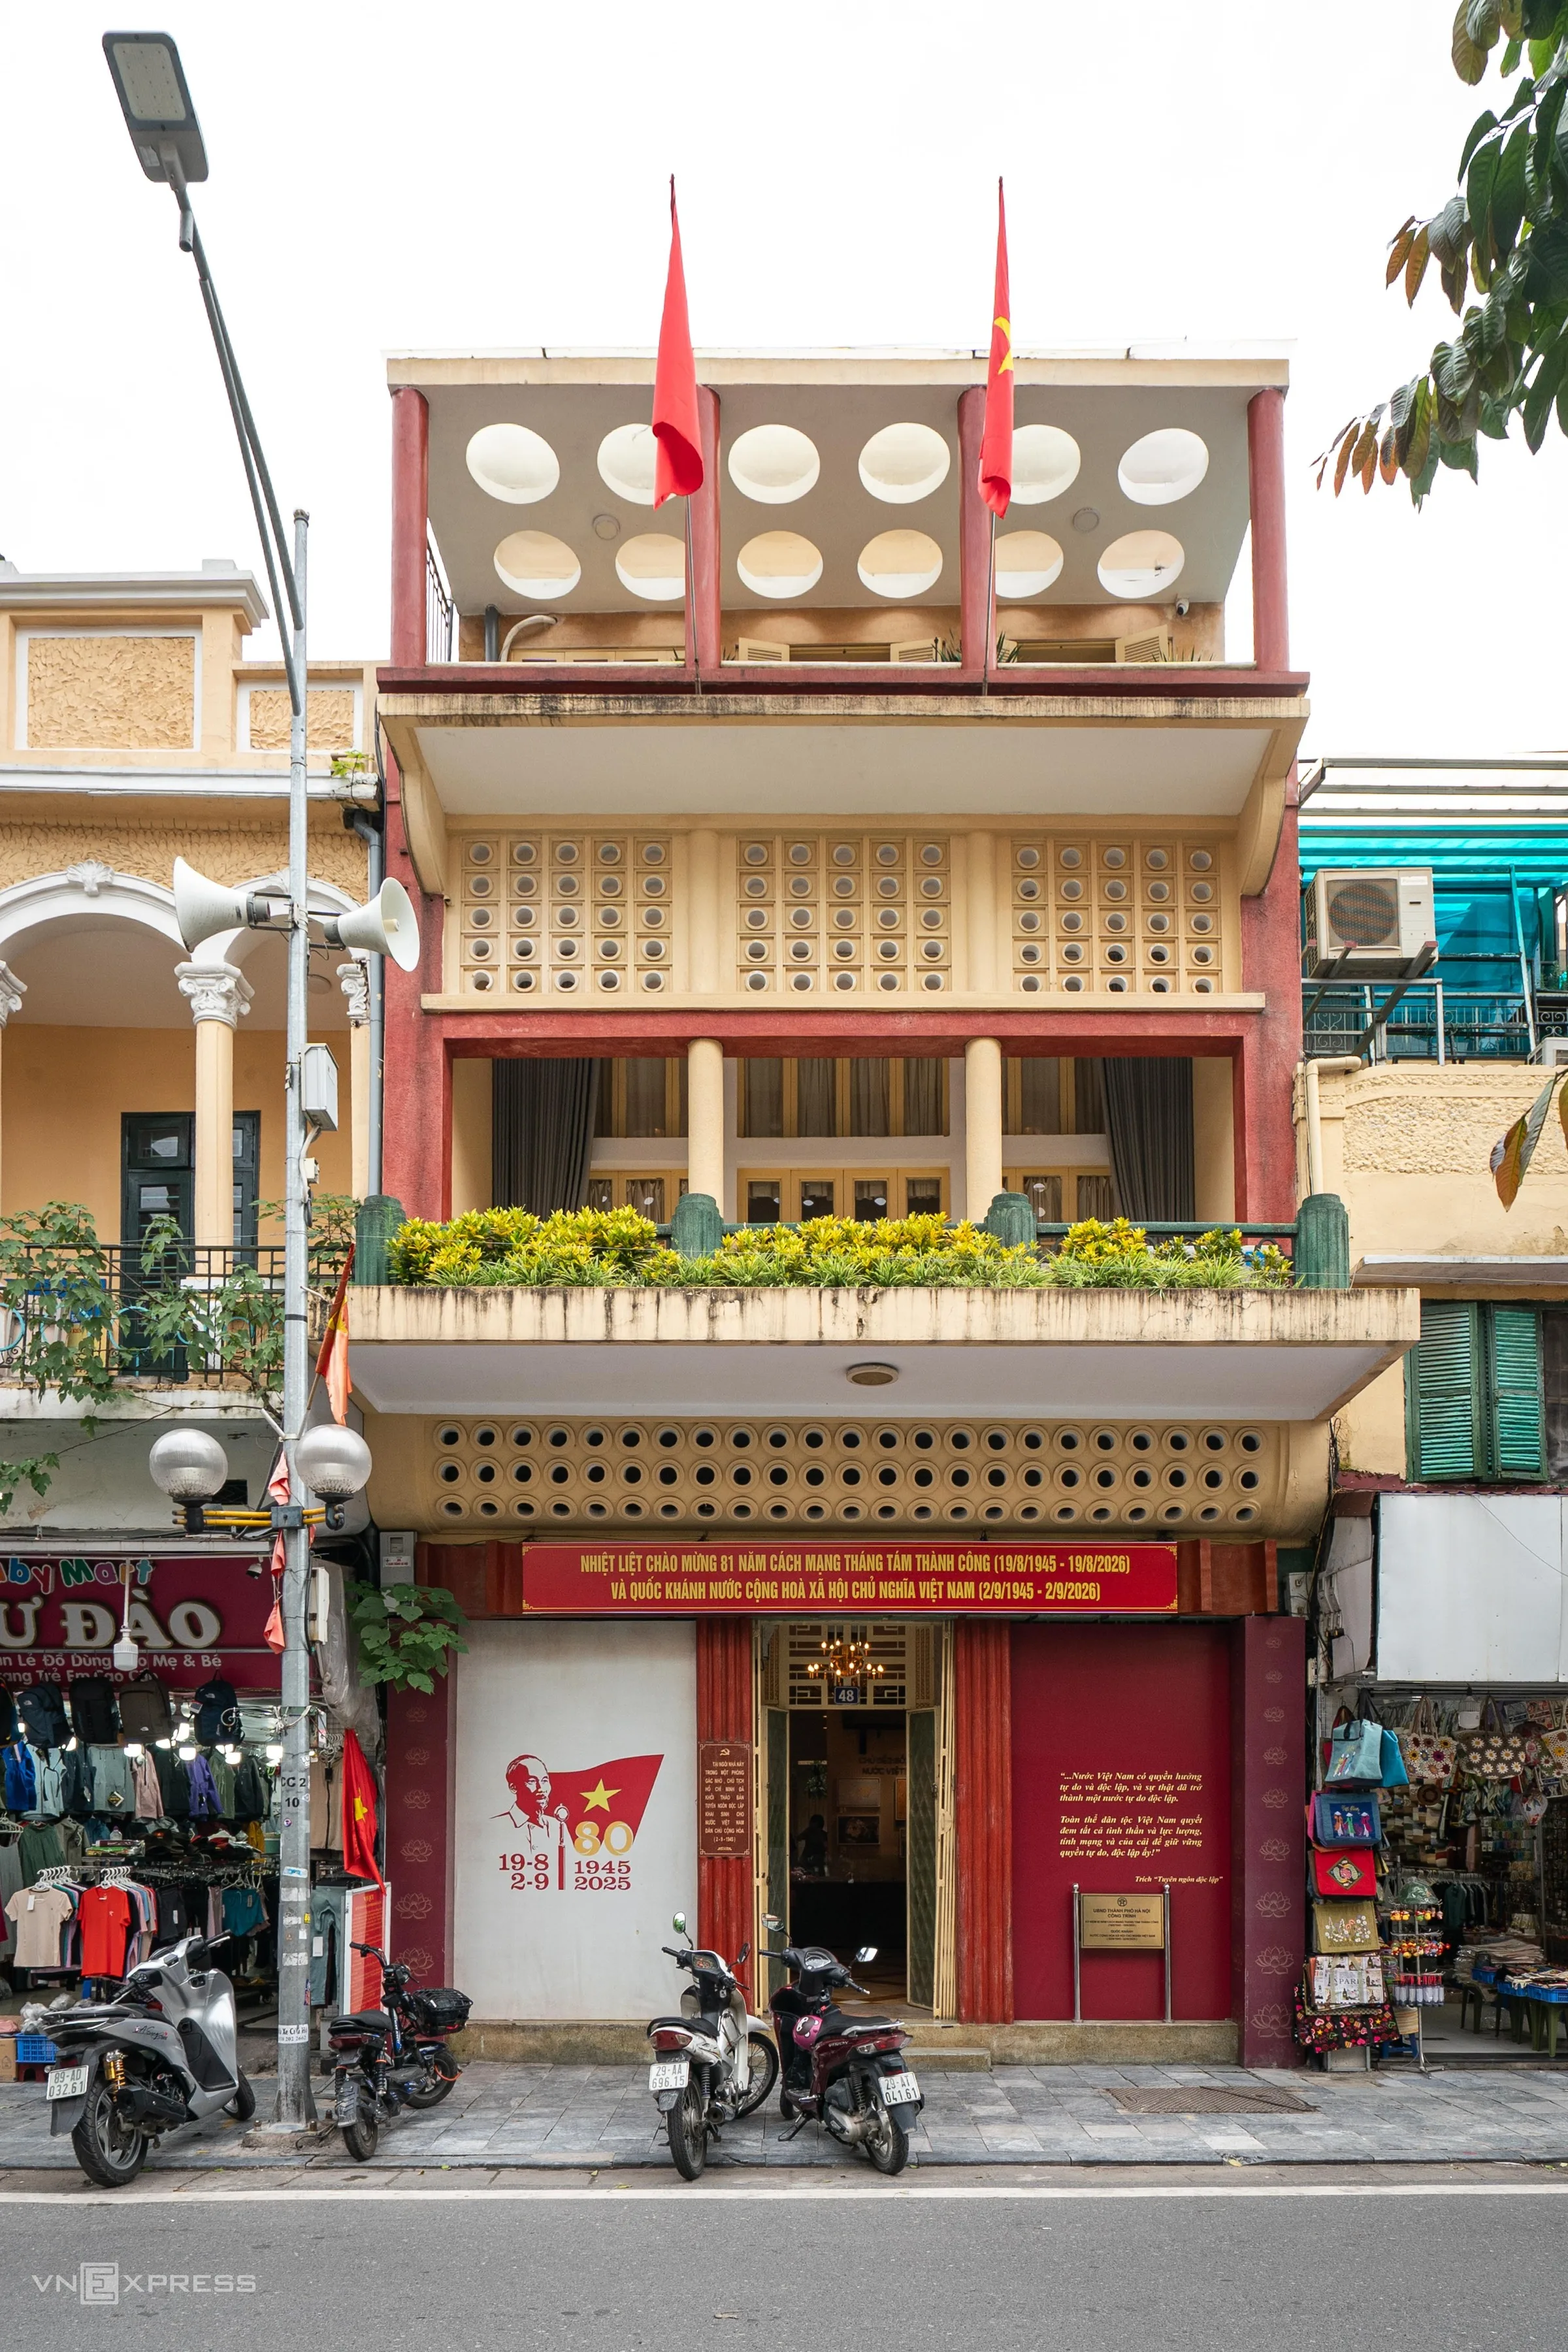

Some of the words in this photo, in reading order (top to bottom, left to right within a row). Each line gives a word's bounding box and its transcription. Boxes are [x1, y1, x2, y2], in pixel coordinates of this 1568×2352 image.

[581, 1551, 615, 1576] NHIỆT
[618, 1551, 643, 1576] LIỆT
[645, 1551, 678, 1573] CHÀO
[681, 1551, 717, 1572] MỪNG
[721, 1554, 734, 1572] 81
[738, 1551, 766, 1572] NĂM
[770, 1550, 802, 1572] CÁCH
[805, 1554, 841, 1575] MẠNG
[843, 1550, 883, 1572] THÁNG
[886, 1550, 912, 1571] TÁM
[915, 1550, 955, 1571] THÀNH
[958, 1550, 990, 1572] CÔNG
[994, 1554, 1056, 1574] (19/8/1945
[1068, 1555, 1130, 1574] 19/8/2026)
[59, 1559, 154, 1588] Mart
[611, 1578, 627, 1599] VÀ
[630, 1576, 662, 1601] QUỐC
[665, 1578, 706, 1599] KHÁNH
[709, 1578, 742, 1599] NƯỚC
[745, 1578, 778, 1603] CỘNG
[781, 1578, 806, 1599] HOÀ
[809, 1578, 825, 1599] XÃ
[828, 1578, 848, 1603] HỘI
[851, 1576, 875, 1599] CHỦ
[879, 1578, 916, 1599] NGHĨA
[919, 1578, 944, 1603] VIỆT
[947, 1581, 975, 1599] NAM
[979, 1581, 1034, 1601] (2/9/1945
[1045, 1582, 1100, 1601] 2/9/2026)
[60, 1589, 221, 1648] ĐÀO
[18, 1652, 36, 1667] Lẻ
[42, 1652, 65, 1667] Đồ
[72, 1654, 112, 1671] Dùng
[153, 1655, 178, 1671] Mẹ
[184, 1655, 196, 1667] &
[201, 1653, 222, 1667] Bé
[838, 1690, 855, 1702] 48
[299, 1778, 306, 1788] 2
[1097, 1772, 1113, 1782] Việt
[1115, 1772, 1135, 1780] Nam
[1136, 1772, 1147, 1780] có
[1148, 1770, 1173, 1782] quyền
[1085, 1782, 1094, 1791] và
[1097, 1783, 1112, 1793] độc
[1114, 1783, 1130, 1793] lập,
[1158, 1783, 1175, 1793] thật
[1177, 1783, 1187, 1791] đã
[286, 1797, 300, 1808] 10
[1059, 1793, 1084, 1802] thành
[1085, 1793, 1102, 1803] một
[1102, 1793, 1124, 1802] nước
[1125, 1795, 1135, 1804] tự
[1147, 1794, 1162, 1804] độc
[1164, 1794, 1179, 1804] lập.
[1060, 1815, 1081, 1823] Toàn
[1120, 1816, 1133, 1825] tộc
[1137, 1816, 1153, 1825] Việt
[1180, 1814, 1203, 1825] quyết
[1060, 1826, 1077, 1835] đem
[1079, 1824, 1091, 1835] tất
[1125, 1825, 1144, 1835] thần
[1159, 1827, 1173, 1837] lực
[1175, 1827, 1202, 1837] lượng,
[574, 1820, 634, 1856] 80
[1105, 1837, 1115, 1846] và
[1151, 1836, 1163, 1846] để
[1164, 1838, 1179, 1848] giữ
[1182, 1838, 1203, 1848] vững
[1060, 1846, 1085, 1858] quyền
[1085, 1849, 1096, 1858] tự
[1096, 1848, 1109, 1857] do,
[1111, 1848, 1126, 1858] độc
[1126, 1848, 1141, 1858] lập
[498, 1853, 549, 1871] 19-8
[574, 1860, 631, 1874] 1945
[511, 1872, 549, 1891] 2-9
[574, 1876, 631, 1891] 2025
[54, 2068, 82, 2084] 89-AD
[655, 2064, 682, 2076] 29-AA
[48, 2081, 84, 2097] 032.61
[652, 2075, 685, 2089] 696.15
[885, 2075, 911, 2090] 29-AT
[885, 2087, 917, 2104] 041.61
